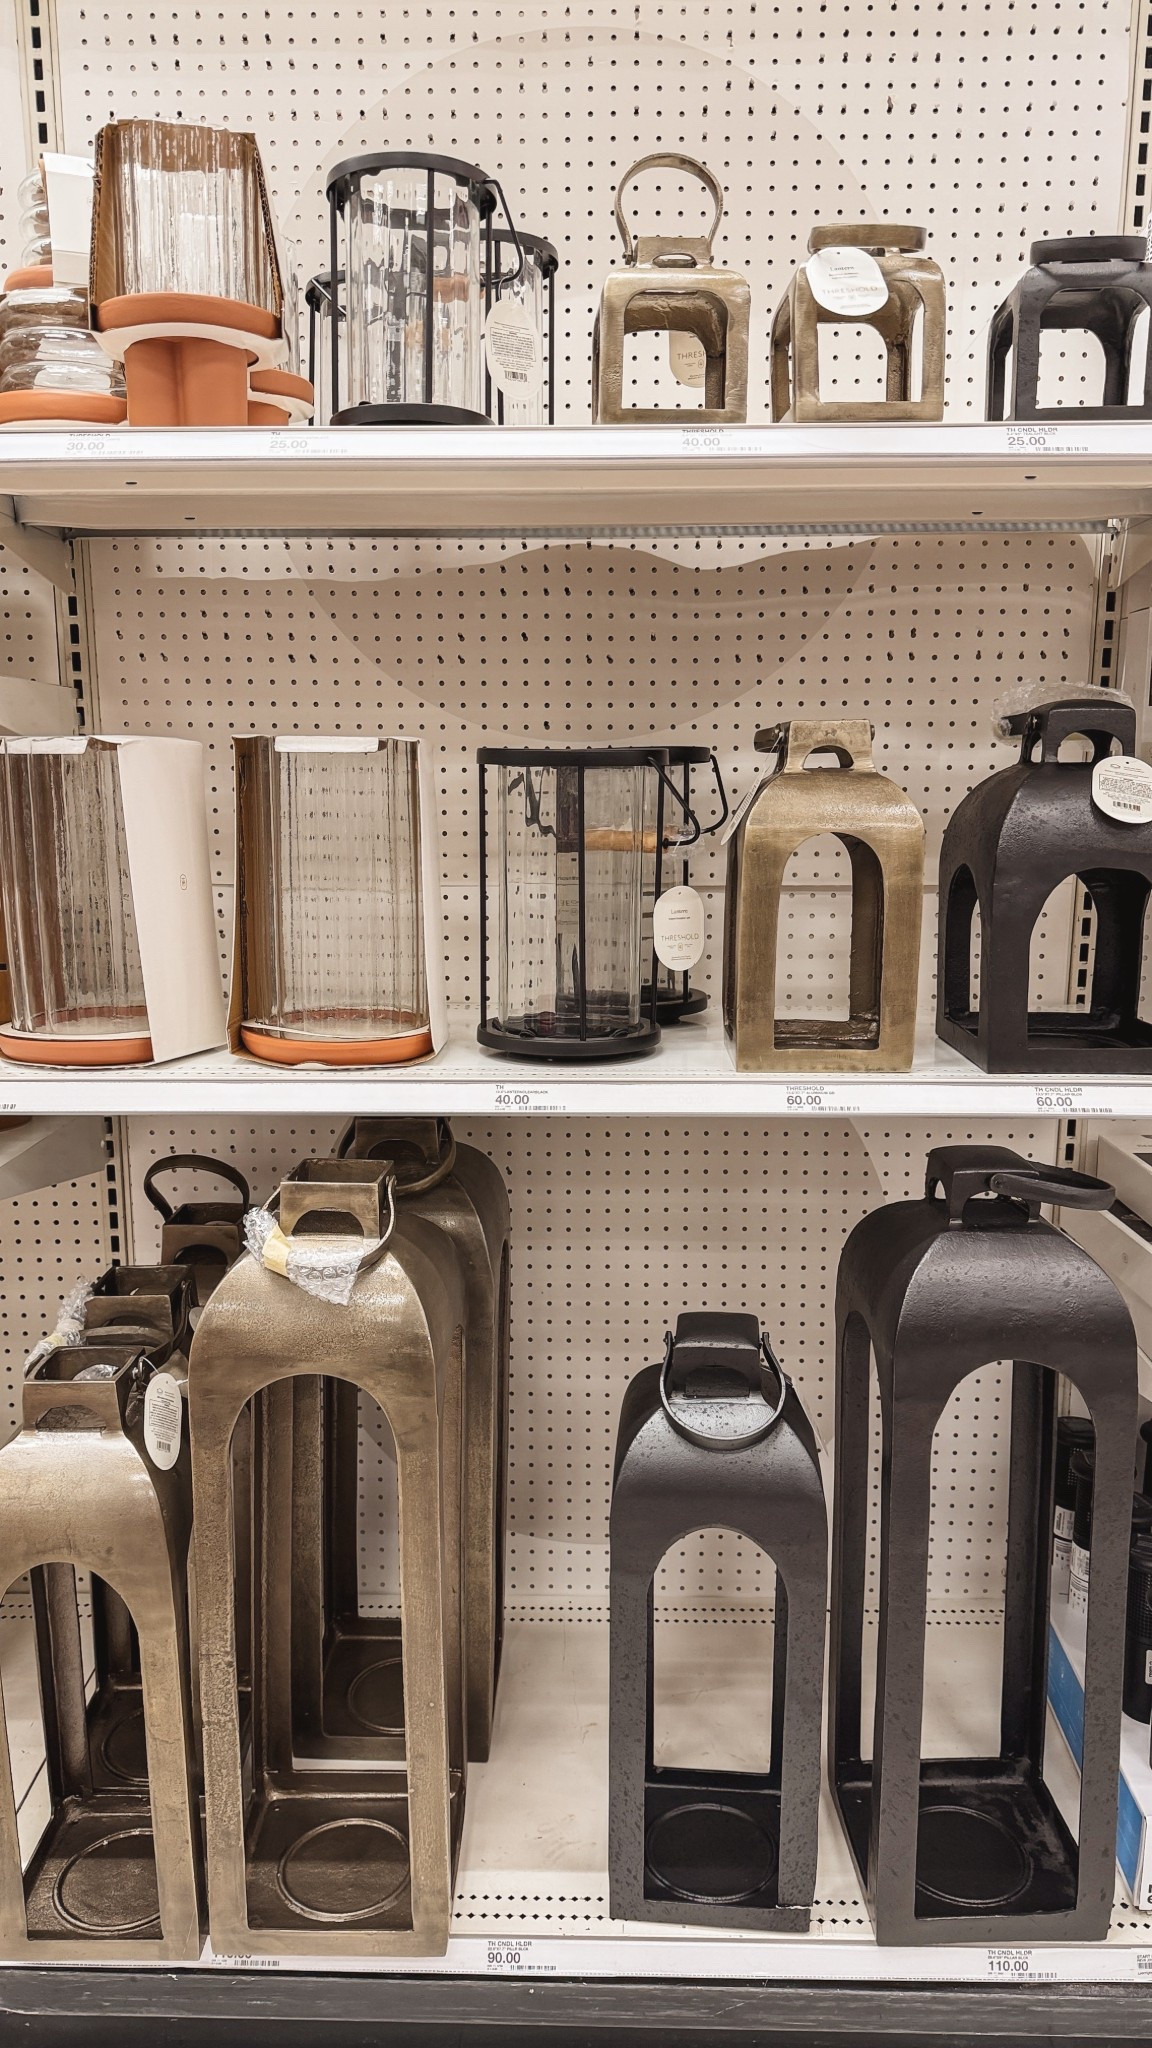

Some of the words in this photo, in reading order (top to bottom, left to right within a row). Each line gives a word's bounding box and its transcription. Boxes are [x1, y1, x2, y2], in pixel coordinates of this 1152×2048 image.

[822, 286, 878, 294] THRESHOLD
[269, 440, 308, 449] 25.00
[682, 437, 720, 446] 40.00
[1008, 436, 1046, 446] 25.00
[66, 442, 105, 451] 30.00
[661, 933, 699, 941] THRESHOLD
[495, 1094, 529, 1104] 40.00
[787, 1095, 822, 1105] 60.00
[1036, 1096, 1072, 1107] 60.00
[488, 1952, 521, 1964] 90.00
[989, 1960, 1029, 1971] 110.00
